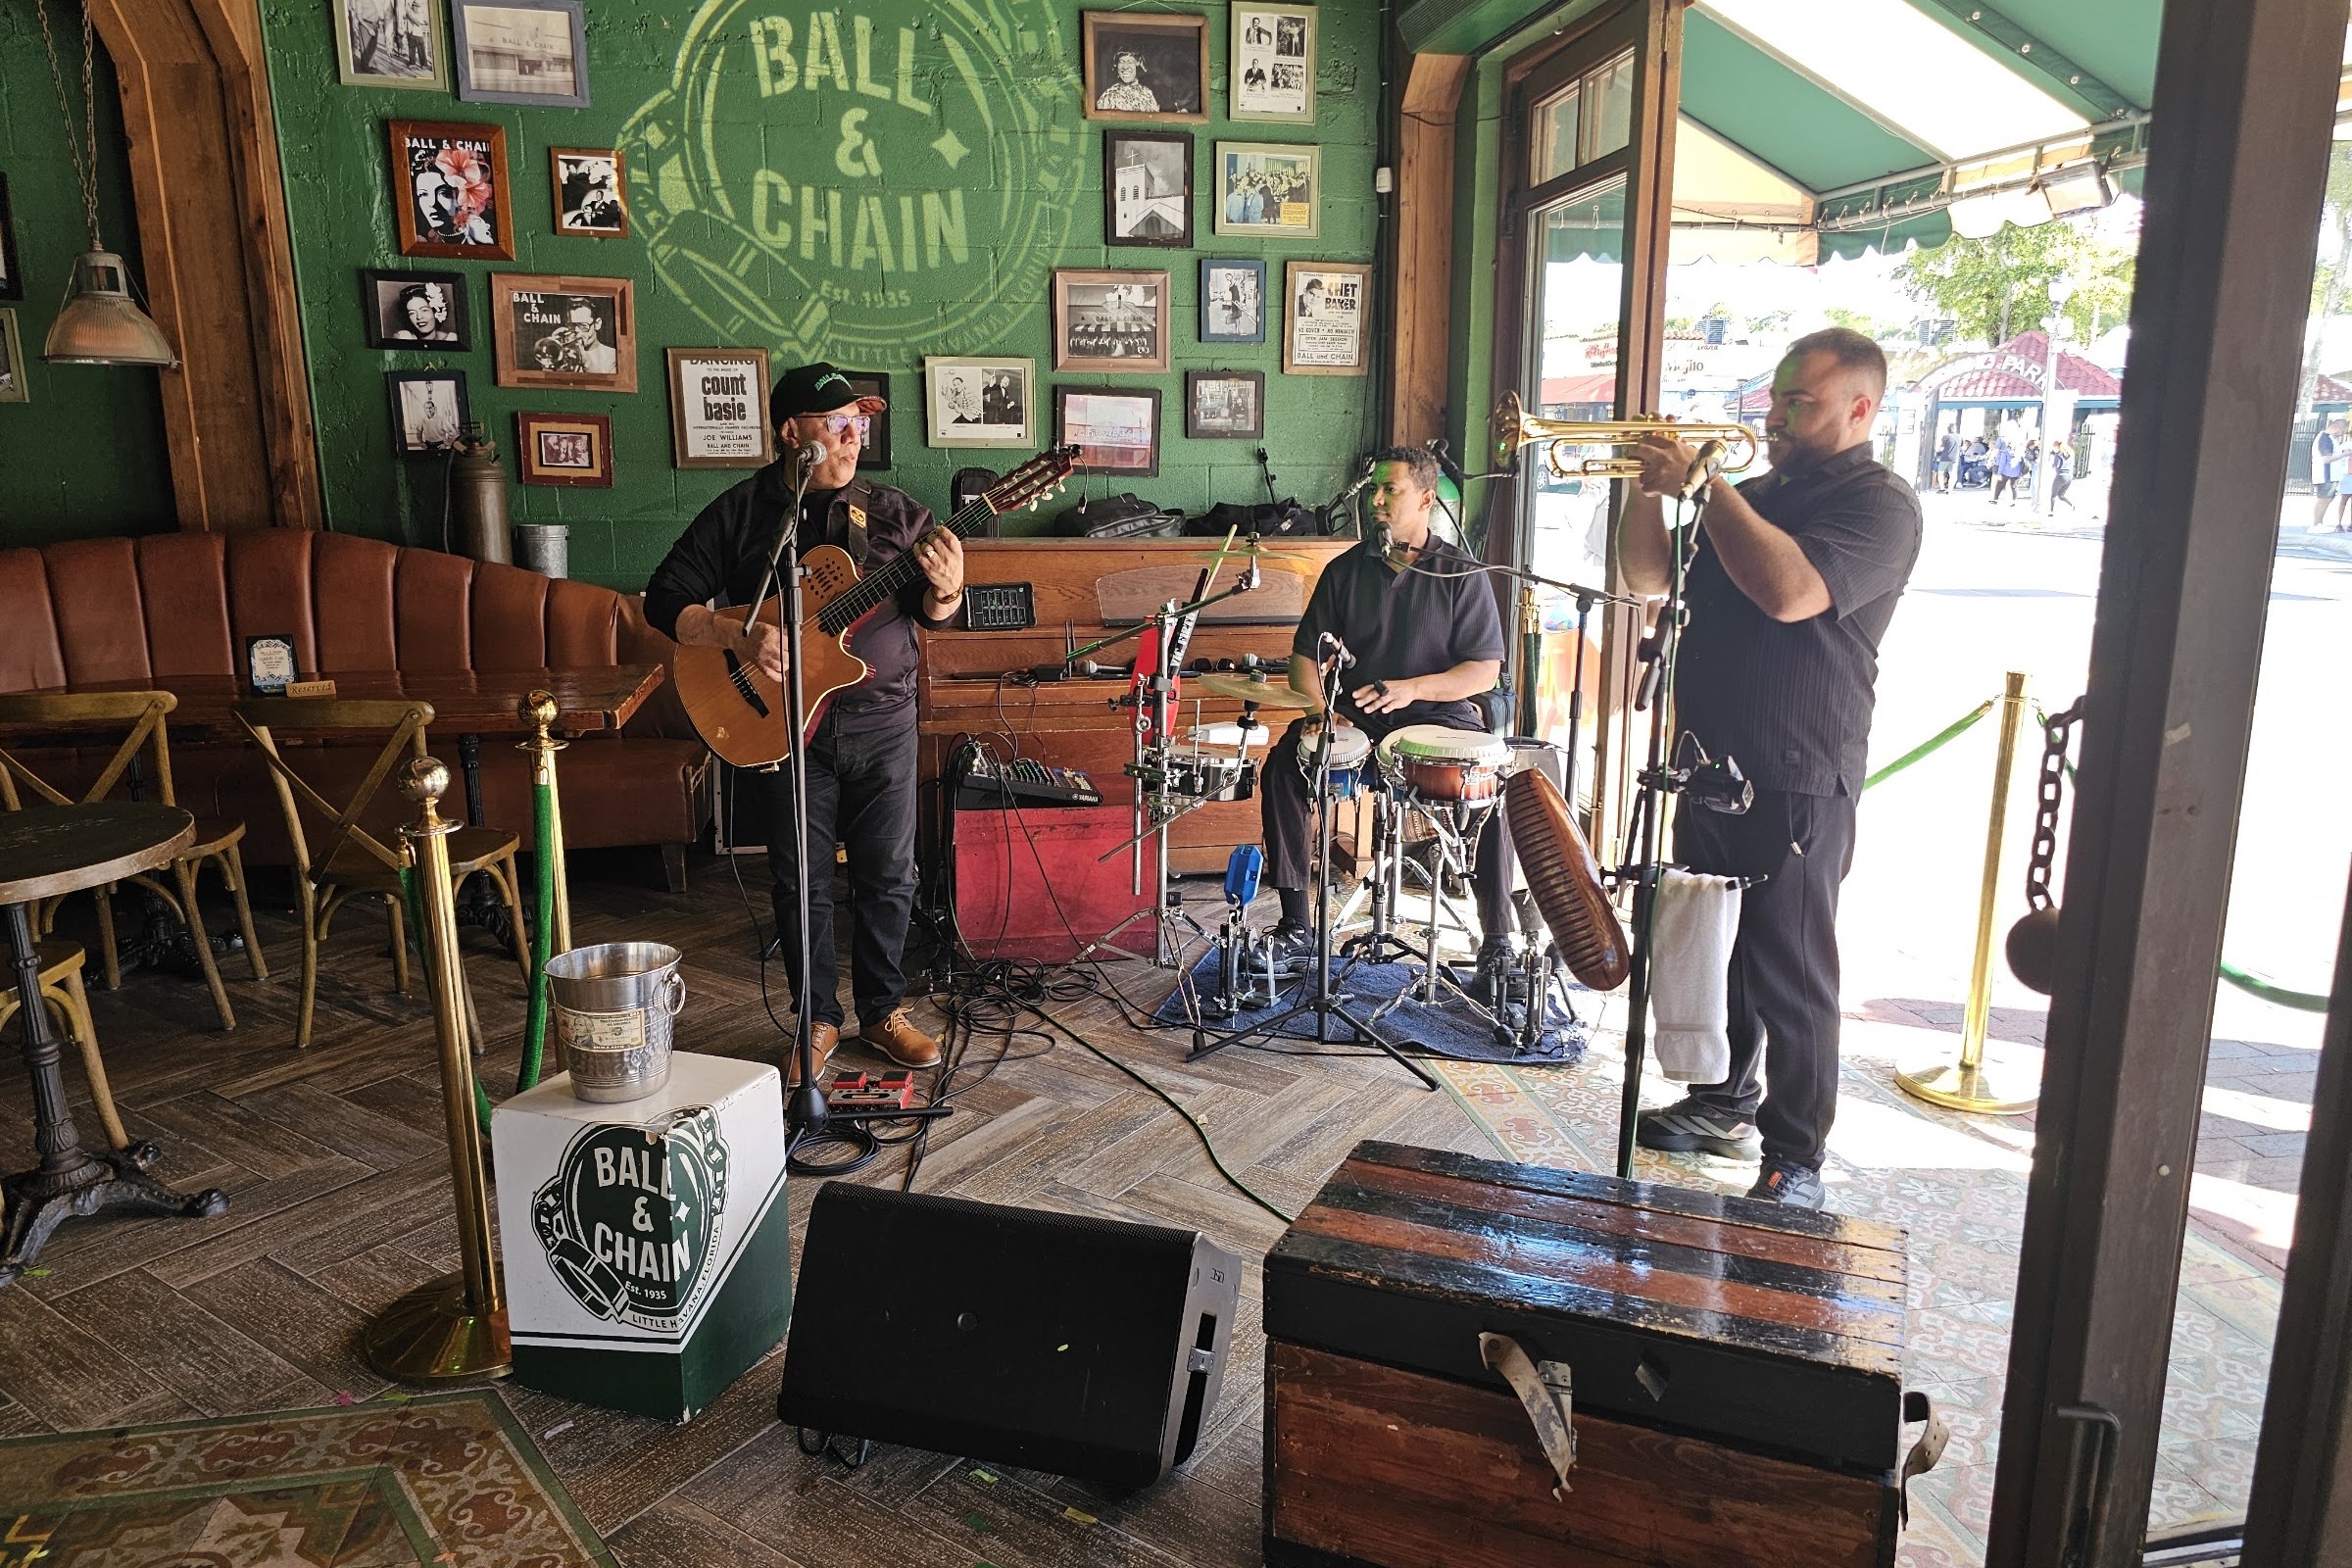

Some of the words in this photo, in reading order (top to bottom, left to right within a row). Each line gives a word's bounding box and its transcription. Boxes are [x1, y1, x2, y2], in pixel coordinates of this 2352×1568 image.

[750, 12, 931, 116] BALL
[405, 137, 436, 149] BALL
[442, 139, 452, 150] &
[836, 108, 882, 176] &
[753, 170, 969, 272] CHAIN
[513, 293, 544, 304] BALL
[1327, 282, 1357, 297] CHET
[530, 303, 539, 313] &
[1325, 297, 1356, 311] BAKER
[523, 313, 562, 323] CHAIN
[702, 373, 747, 395] count
[704, 397, 746, 420] basie
[289, 682, 331, 694] Reserved
[594, 1147, 677, 1201] BALL
[632, 1196, 654, 1232] &
[594, 1222, 691, 1282] CHAIN
[632, 1314, 667, 1328] LITTLE
[702, 1226, 720, 1281] FLORIDA
[624, 1280, 642, 1296] Est.
[644, 1289, 667, 1299] 1935
